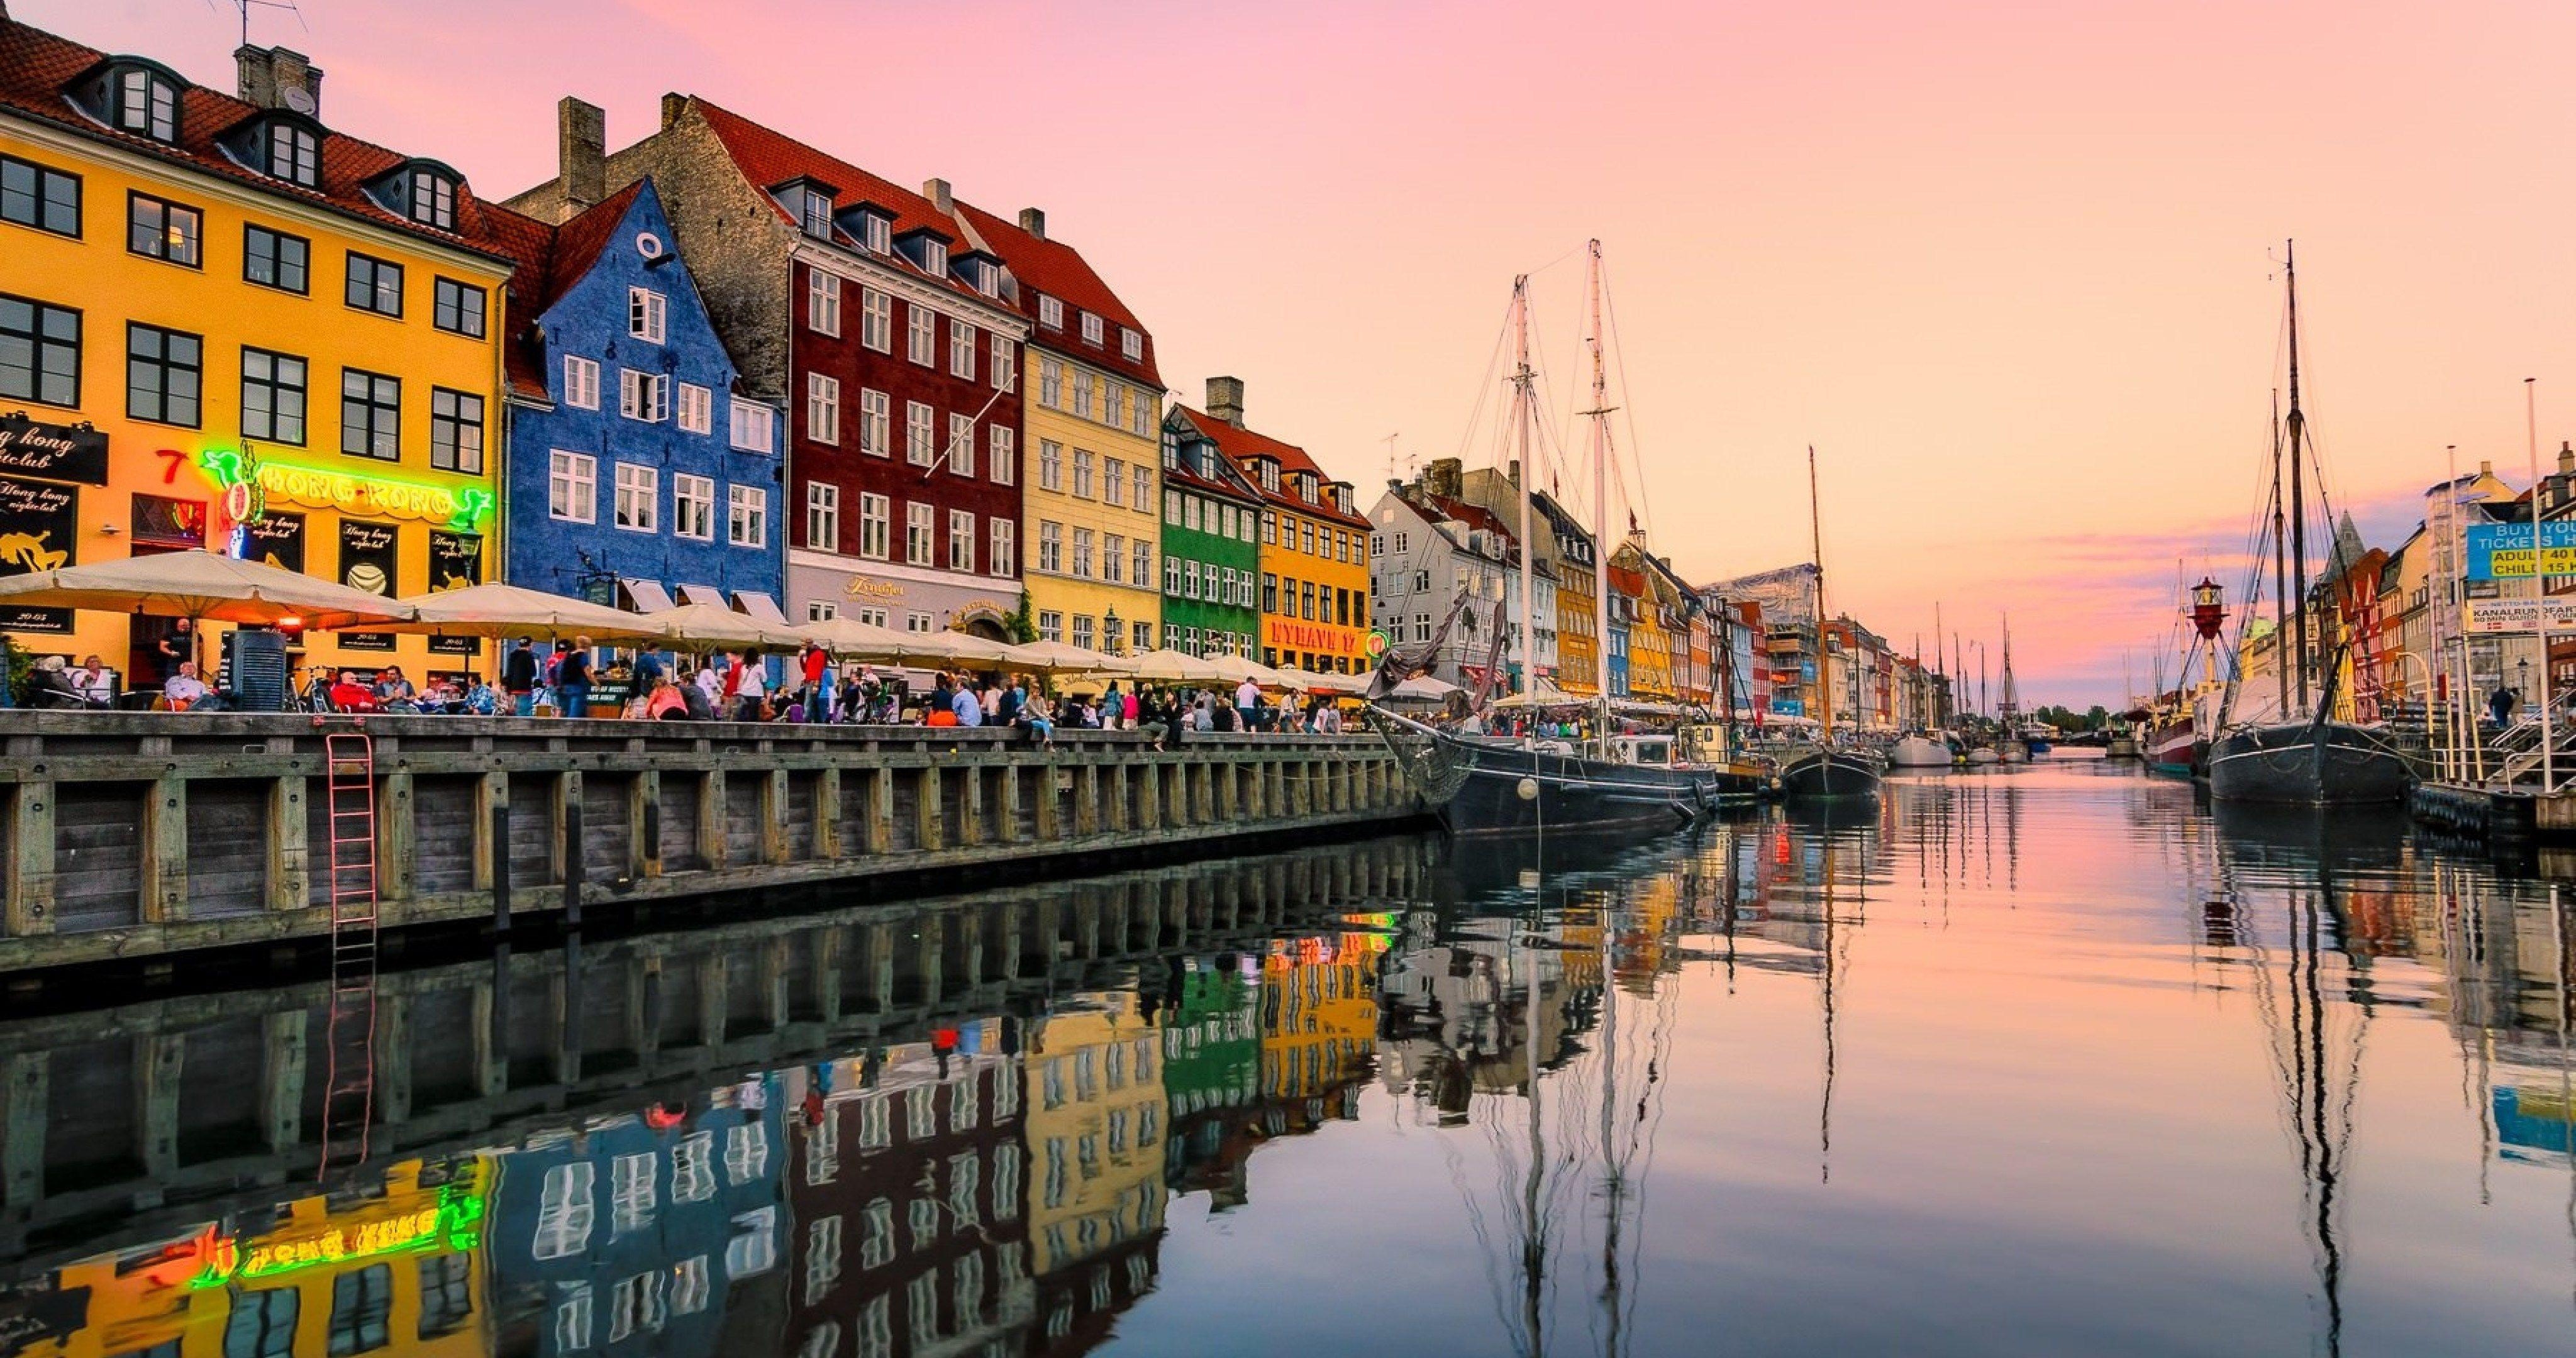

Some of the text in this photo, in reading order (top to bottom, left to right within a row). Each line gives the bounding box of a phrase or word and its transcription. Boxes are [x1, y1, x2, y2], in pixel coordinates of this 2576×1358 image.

[156, 450, 189, 483] 7
[2497, 524, 2532, 536] BUY
[2550, 549, 2568, 559] 40
[2548, 563, 2565, 572] 15
